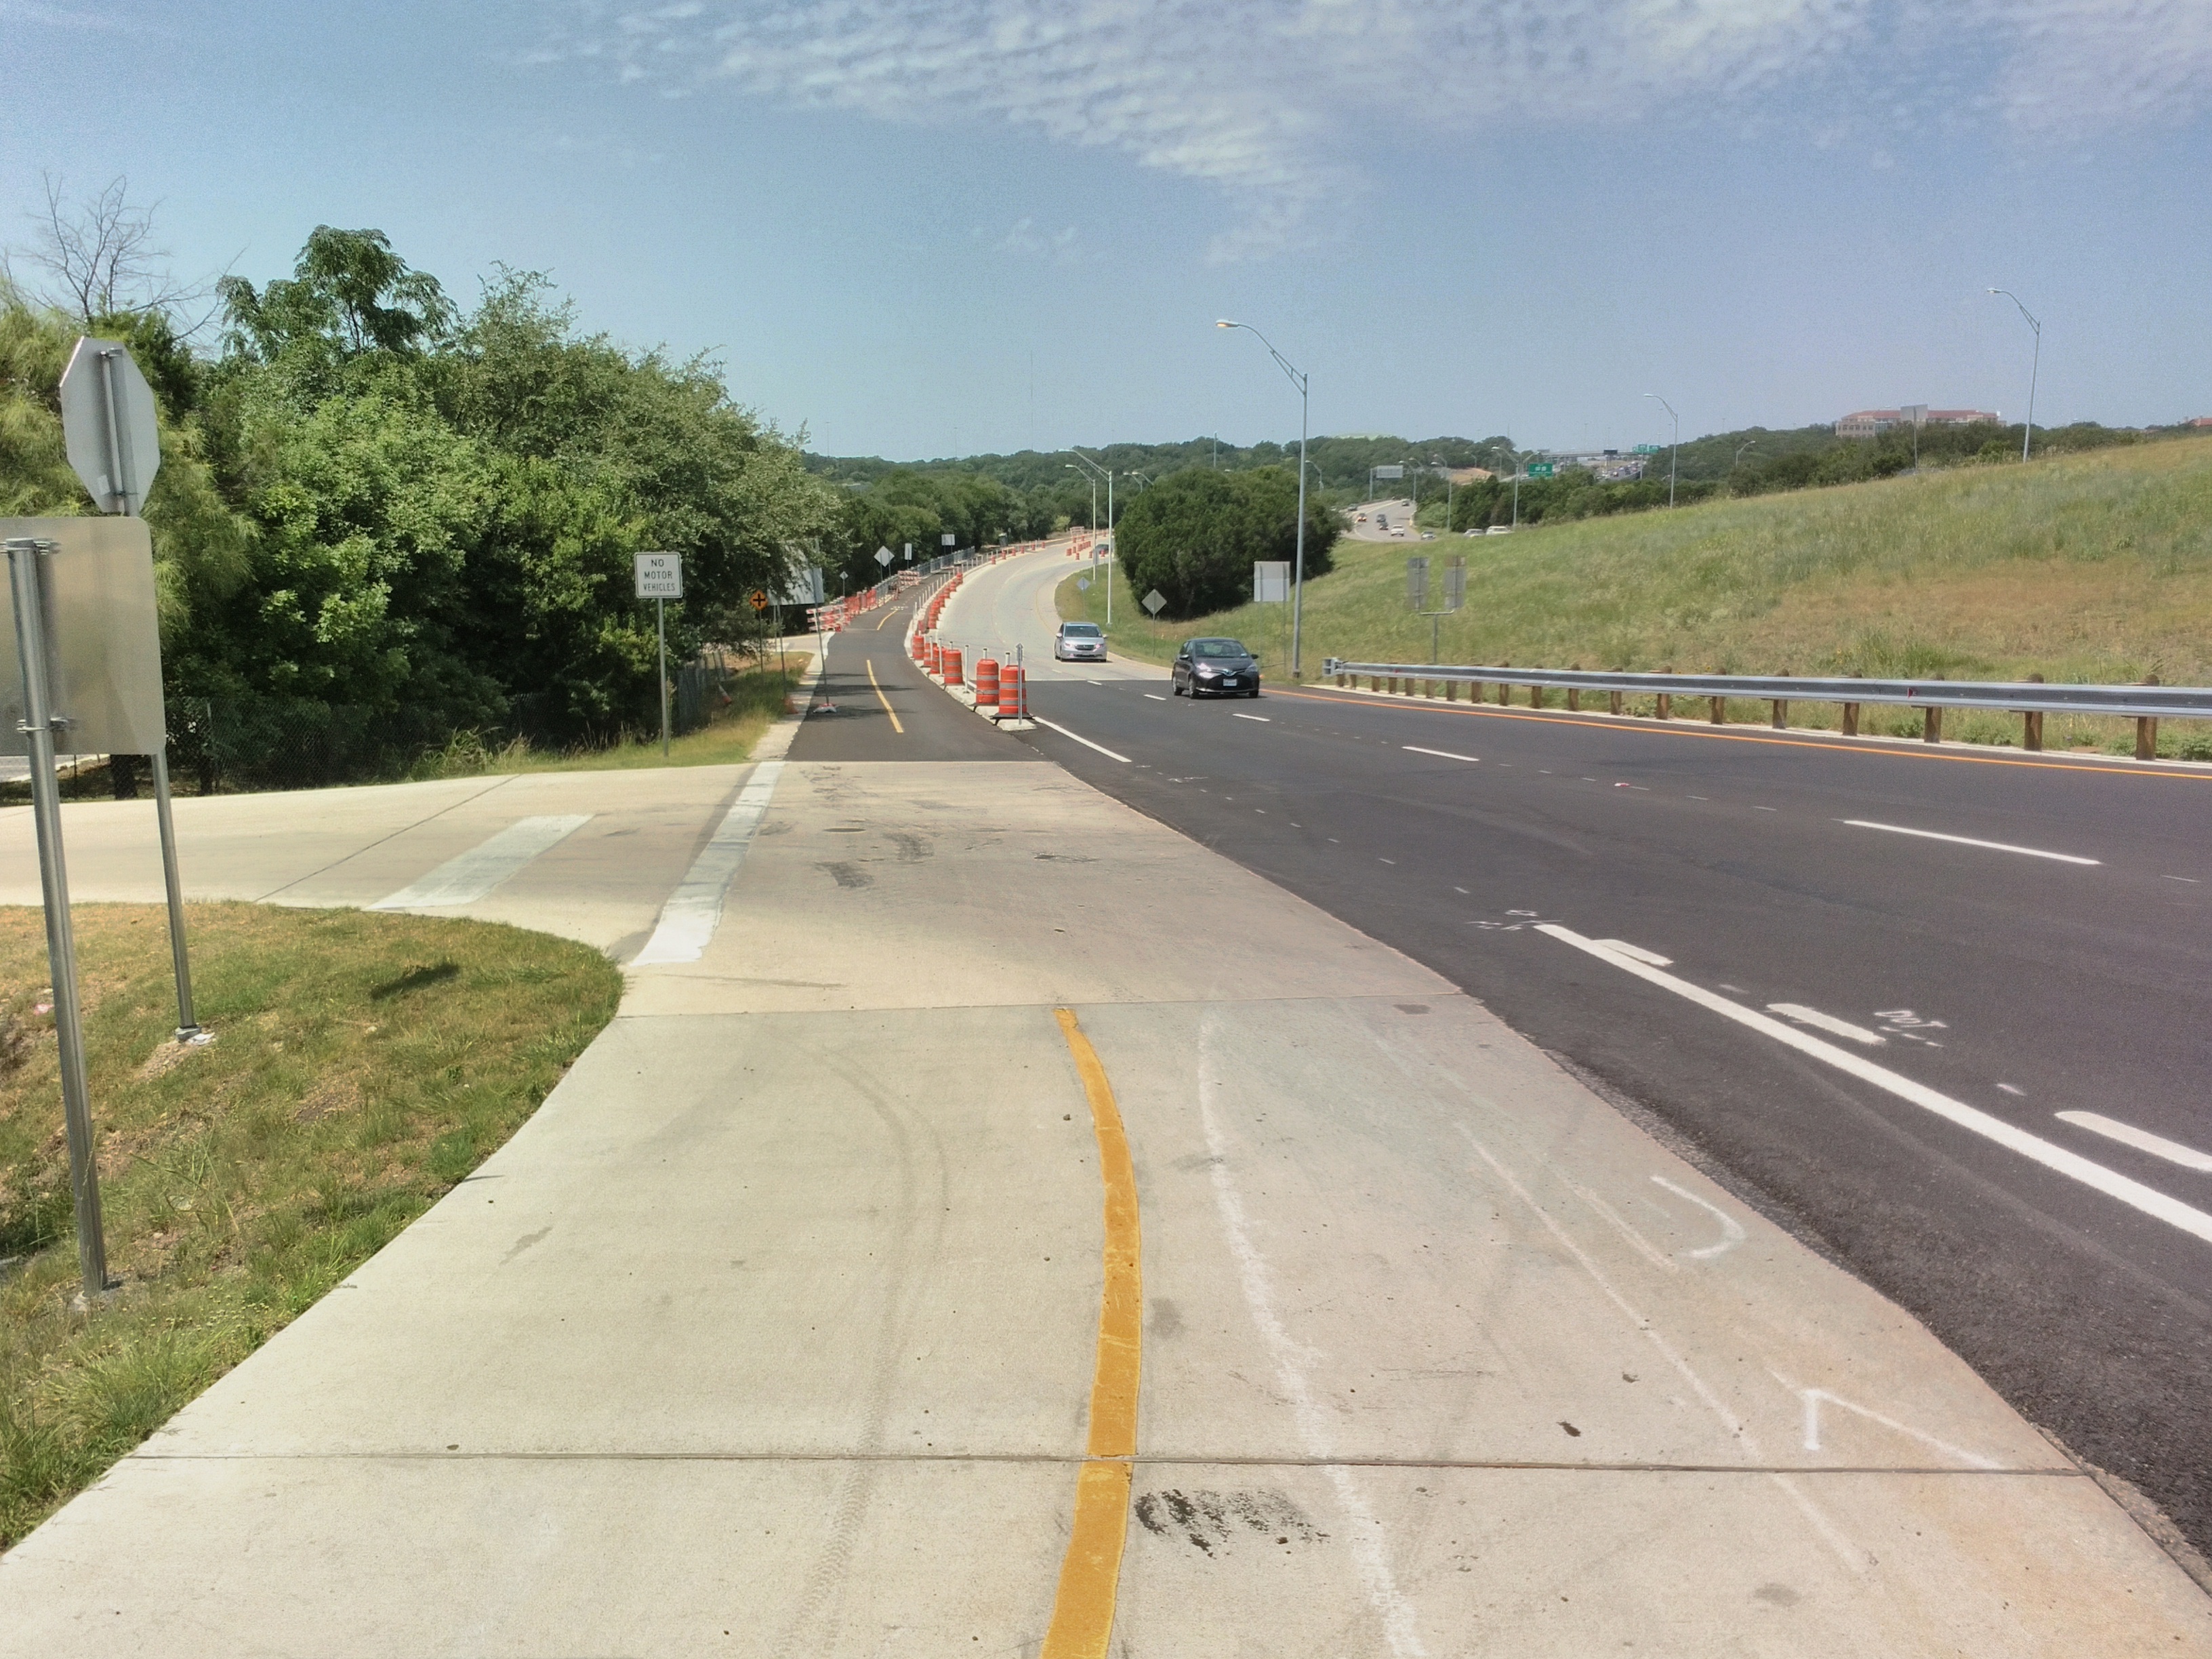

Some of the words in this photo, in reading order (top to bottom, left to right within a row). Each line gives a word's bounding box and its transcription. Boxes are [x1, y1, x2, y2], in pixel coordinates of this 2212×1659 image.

[651, 558, 664, 567] NO
[644, 571, 672, 579] MOTOR
[643, 583, 675, 592] VEHICLES
